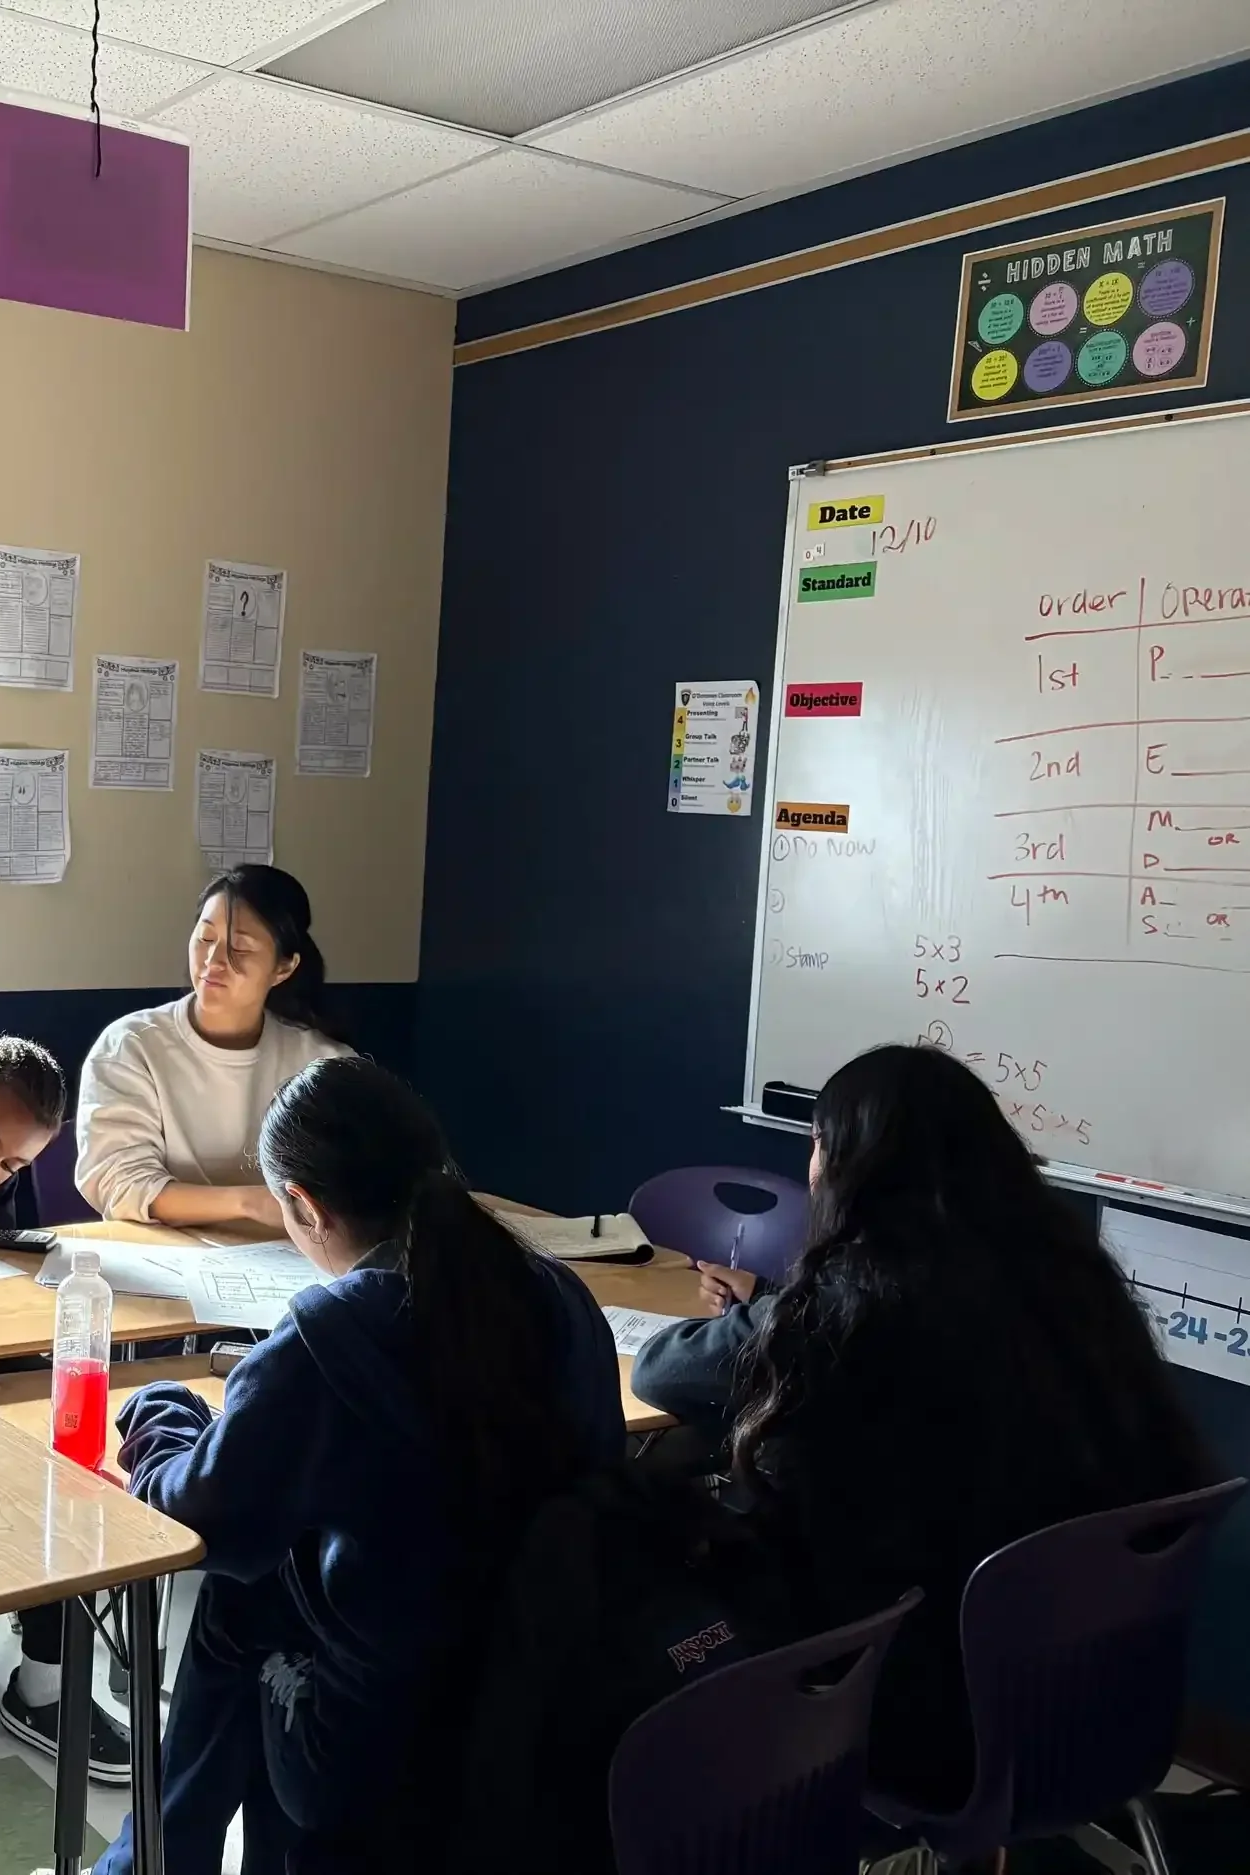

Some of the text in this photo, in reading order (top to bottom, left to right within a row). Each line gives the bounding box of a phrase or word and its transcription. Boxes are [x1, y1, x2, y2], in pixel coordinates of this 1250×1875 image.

[1006, 229, 1173, 284] HIDDEN MATH
[818, 504, 871, 524] Date
[871, 516, 937, 556] 12/10
[801, 571, 872, 592] Standard
[1162, 580, 1250, 619] Opera
[1038, 653, 1079, 693] 1st
[790, 692, 858, 710] Objective
[677, 715, 684, 724] 4
[686, 709, 718, 717] Presenting
[675, 739, 682, 748] 3
[673, 760, 680, 769] 2
[1029, 743, 1168, 781] 2nd E
[671, 798, 678, 807] 0
[776, 808, 847, 827] Agenda
[1015, 832, 1065, 861] 3rd
[1207, 833, 1240, 845] OR
[1206, 913, 1230, 927] OR
[1156, 1311, 1250, 1357] -24 -2
